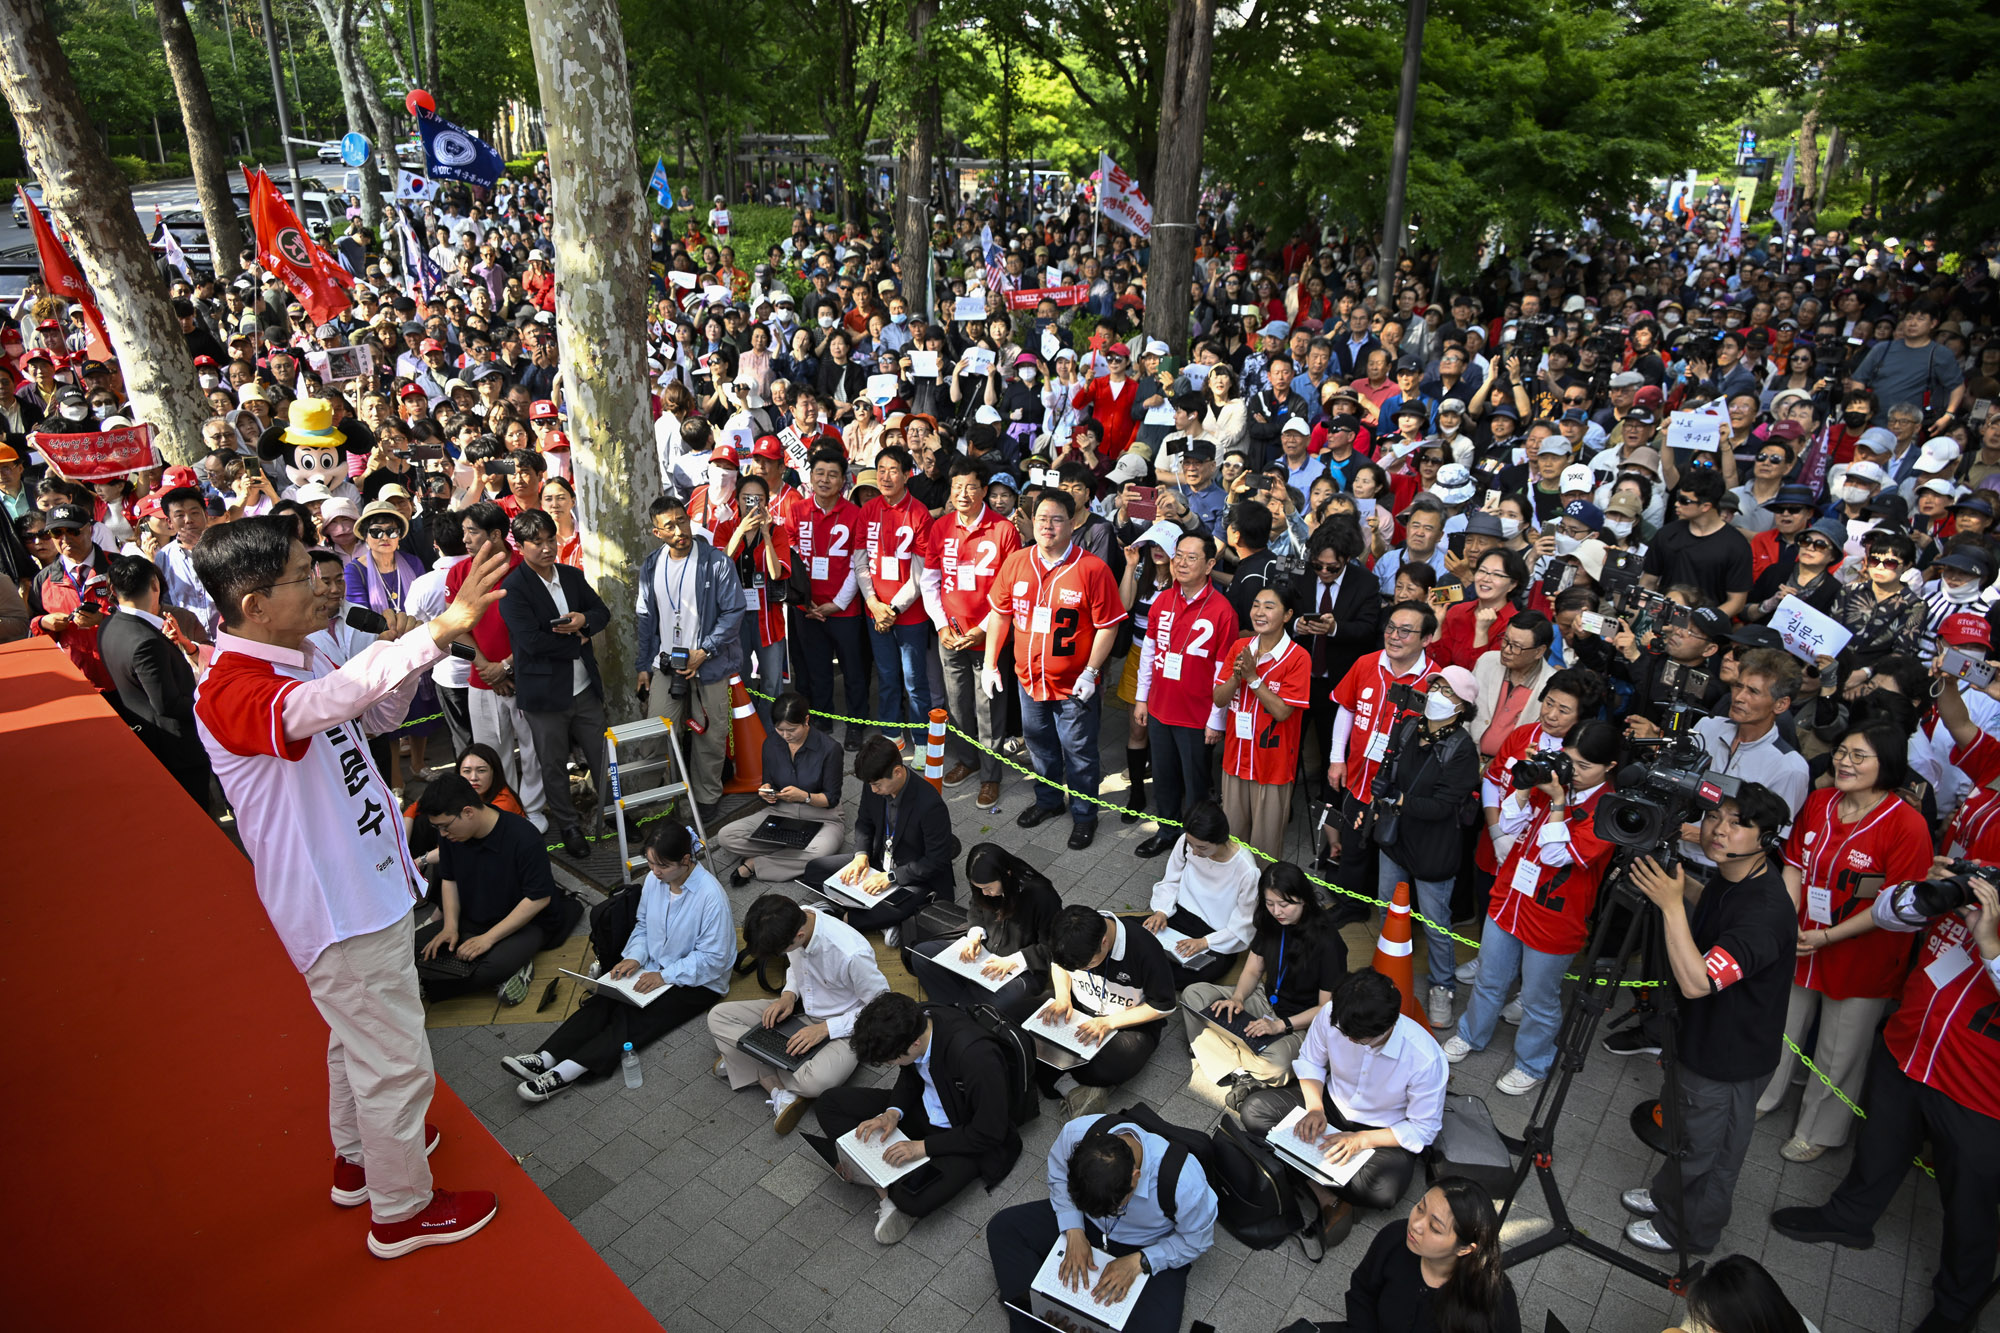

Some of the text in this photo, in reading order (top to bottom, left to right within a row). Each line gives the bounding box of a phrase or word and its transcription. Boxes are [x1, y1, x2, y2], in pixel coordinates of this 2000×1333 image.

[828, 524, 850, 557] 2
[866, 521, 881, 575] 김문수
[895, 525, 914, 560] 2
[942, 538, 960, 594] 김문수
[975, 540, 997, 576] 2
[1052, 607, 1079, 656] 2
[1186, 618, 1214, 658] 2
[1787, 617, 1825, 646] 김문수
[1957, 618, 1975, 626] STOP
[1961, 627, 1982, 637] STEAL
[1154, 610, 1175, 671] 김문수
[1356, 700, 1373, 717] 국민
[1847, 855, 1871, 868] POWER
[1850, 848, 1873, 863] PEOPLE
